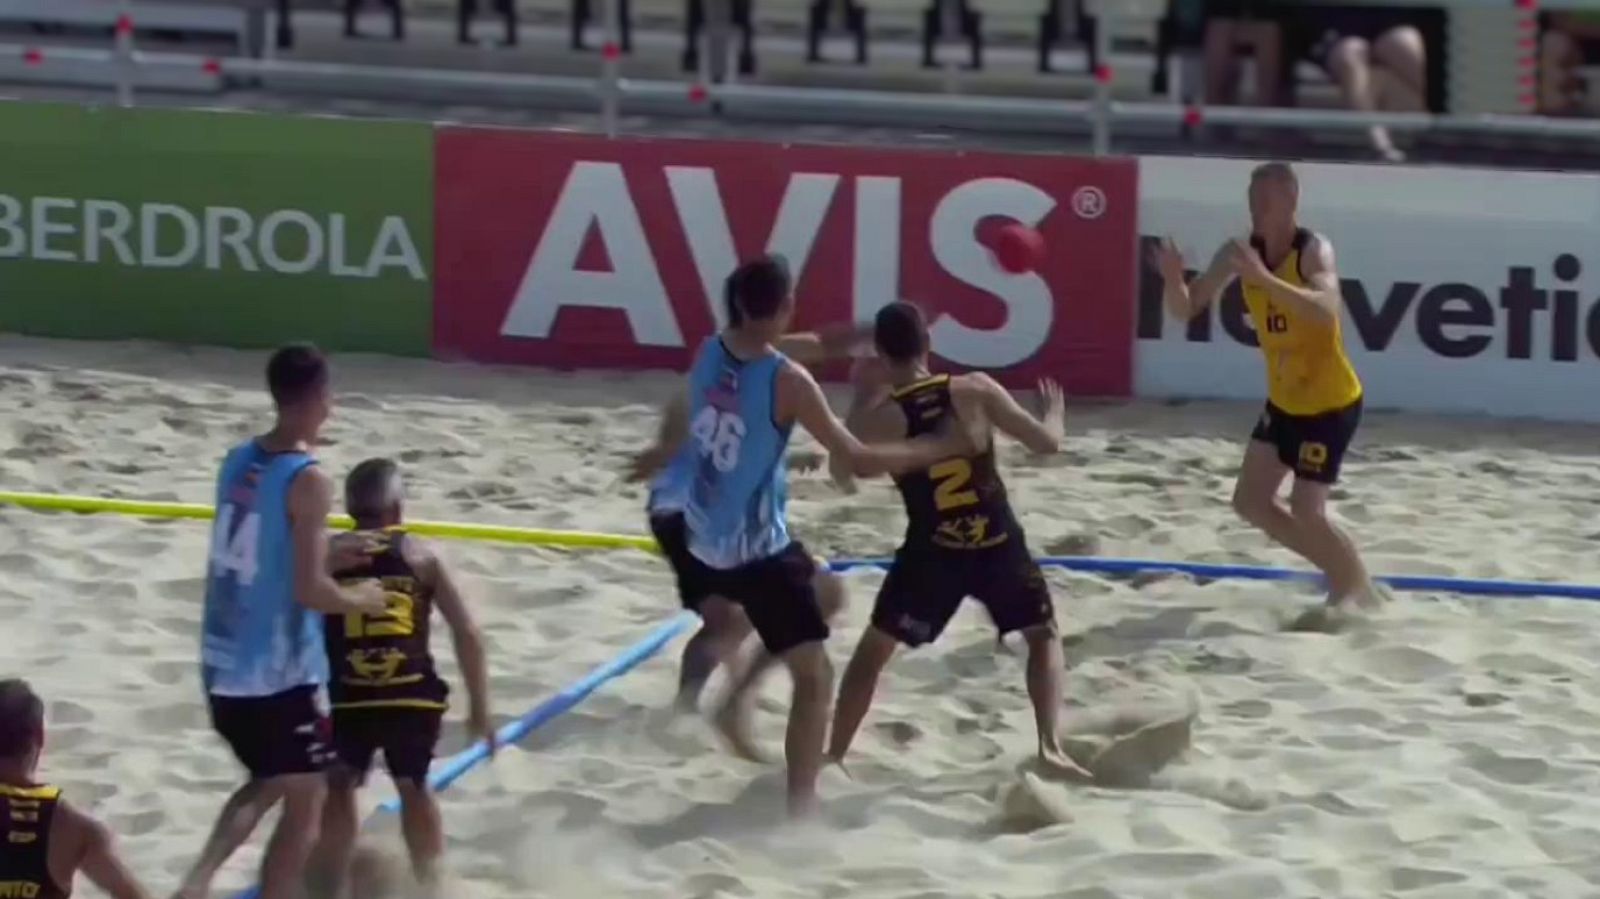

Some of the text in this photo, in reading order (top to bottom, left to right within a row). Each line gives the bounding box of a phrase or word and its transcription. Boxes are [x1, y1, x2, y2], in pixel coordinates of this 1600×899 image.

[500, 160, 1057, 369] AVIS
[1266, 314, 1288, 333] 10
[929, 457, 980, 511] 2
